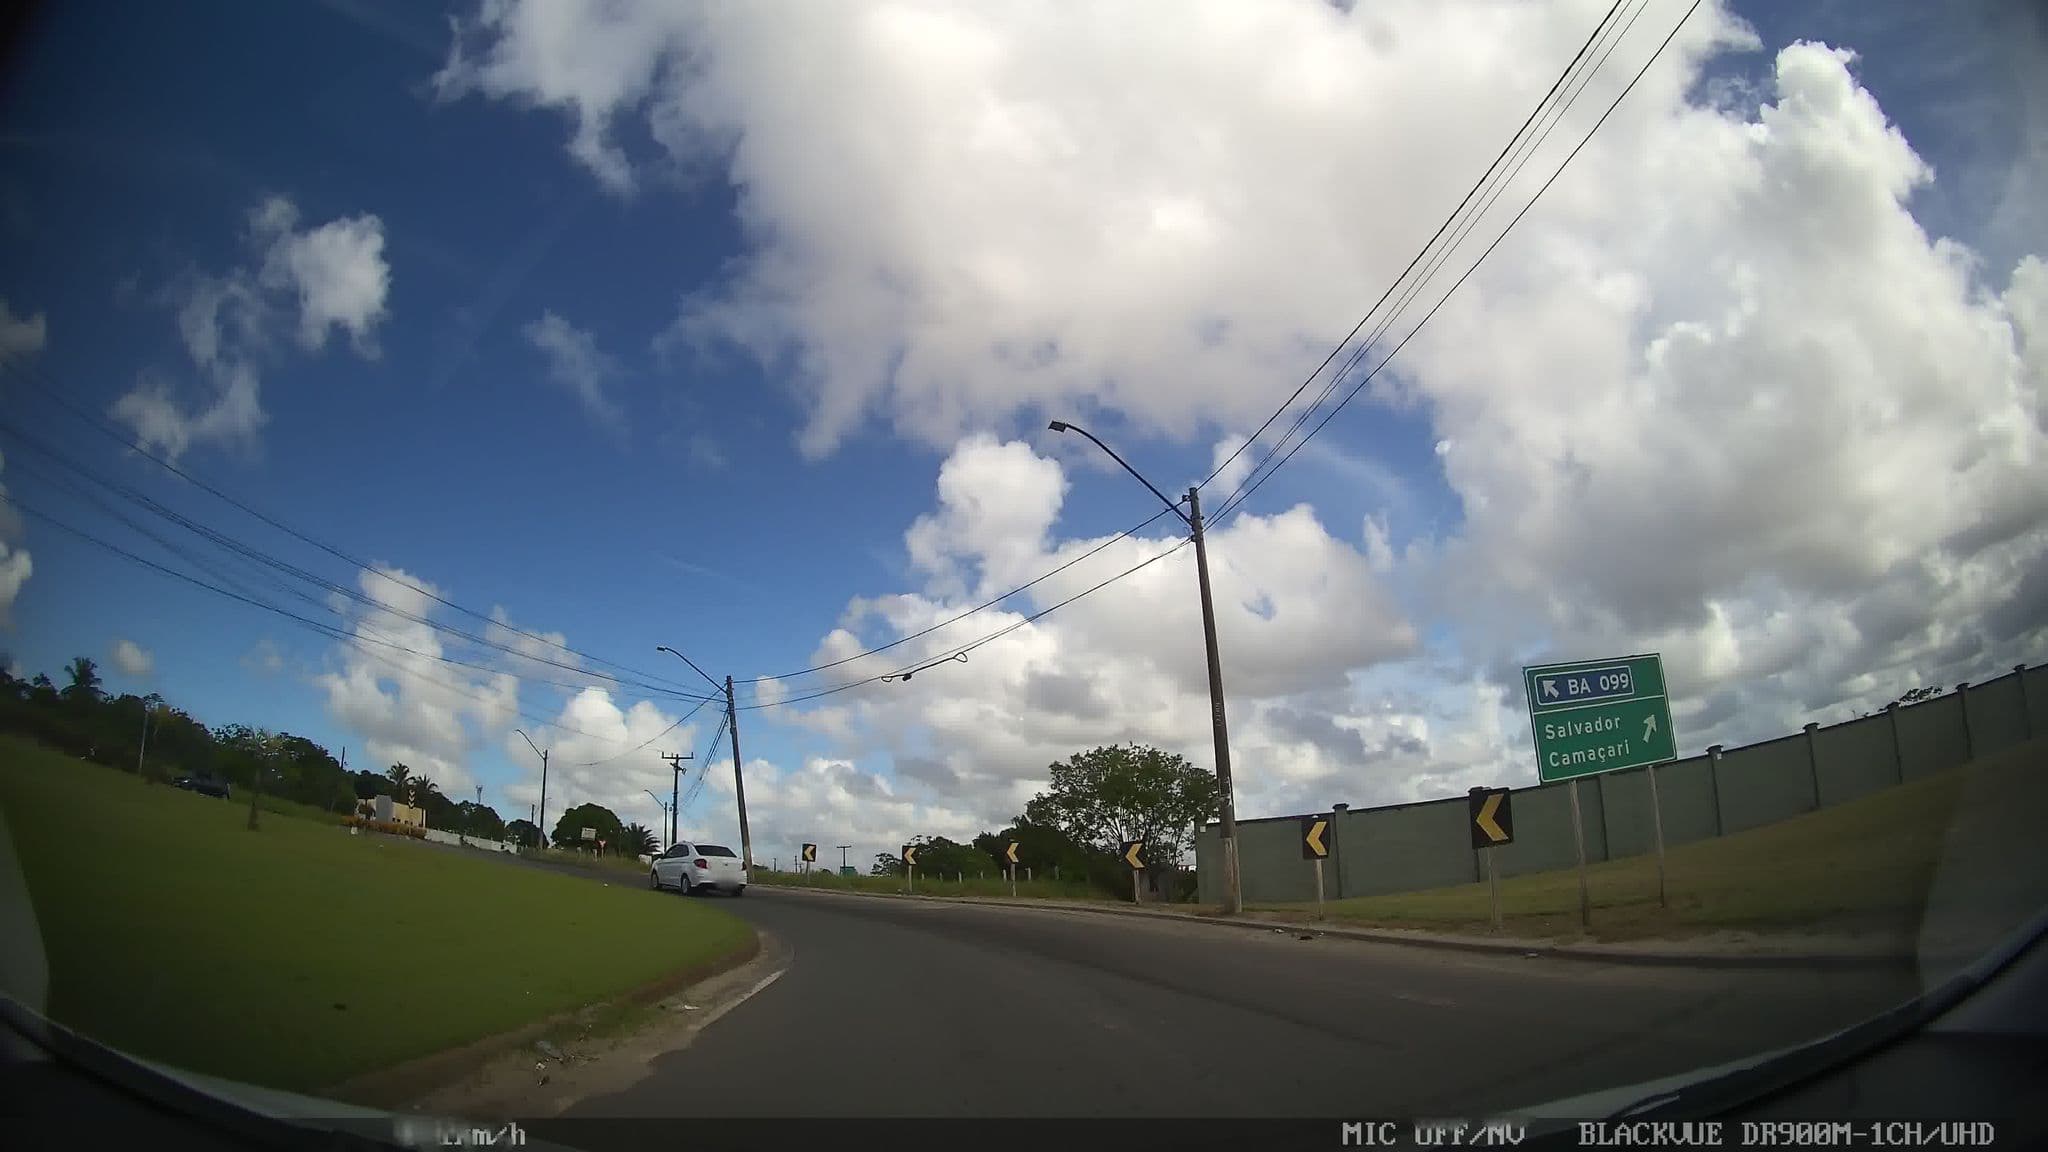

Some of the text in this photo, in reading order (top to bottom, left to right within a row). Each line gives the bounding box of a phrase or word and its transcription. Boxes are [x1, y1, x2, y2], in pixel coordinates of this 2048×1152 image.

[1567, 673, 1629, 695] BA 099
[1545, 716, 1621, 740] Salvador
[1549, 739, 1631, 767] Camaçari
